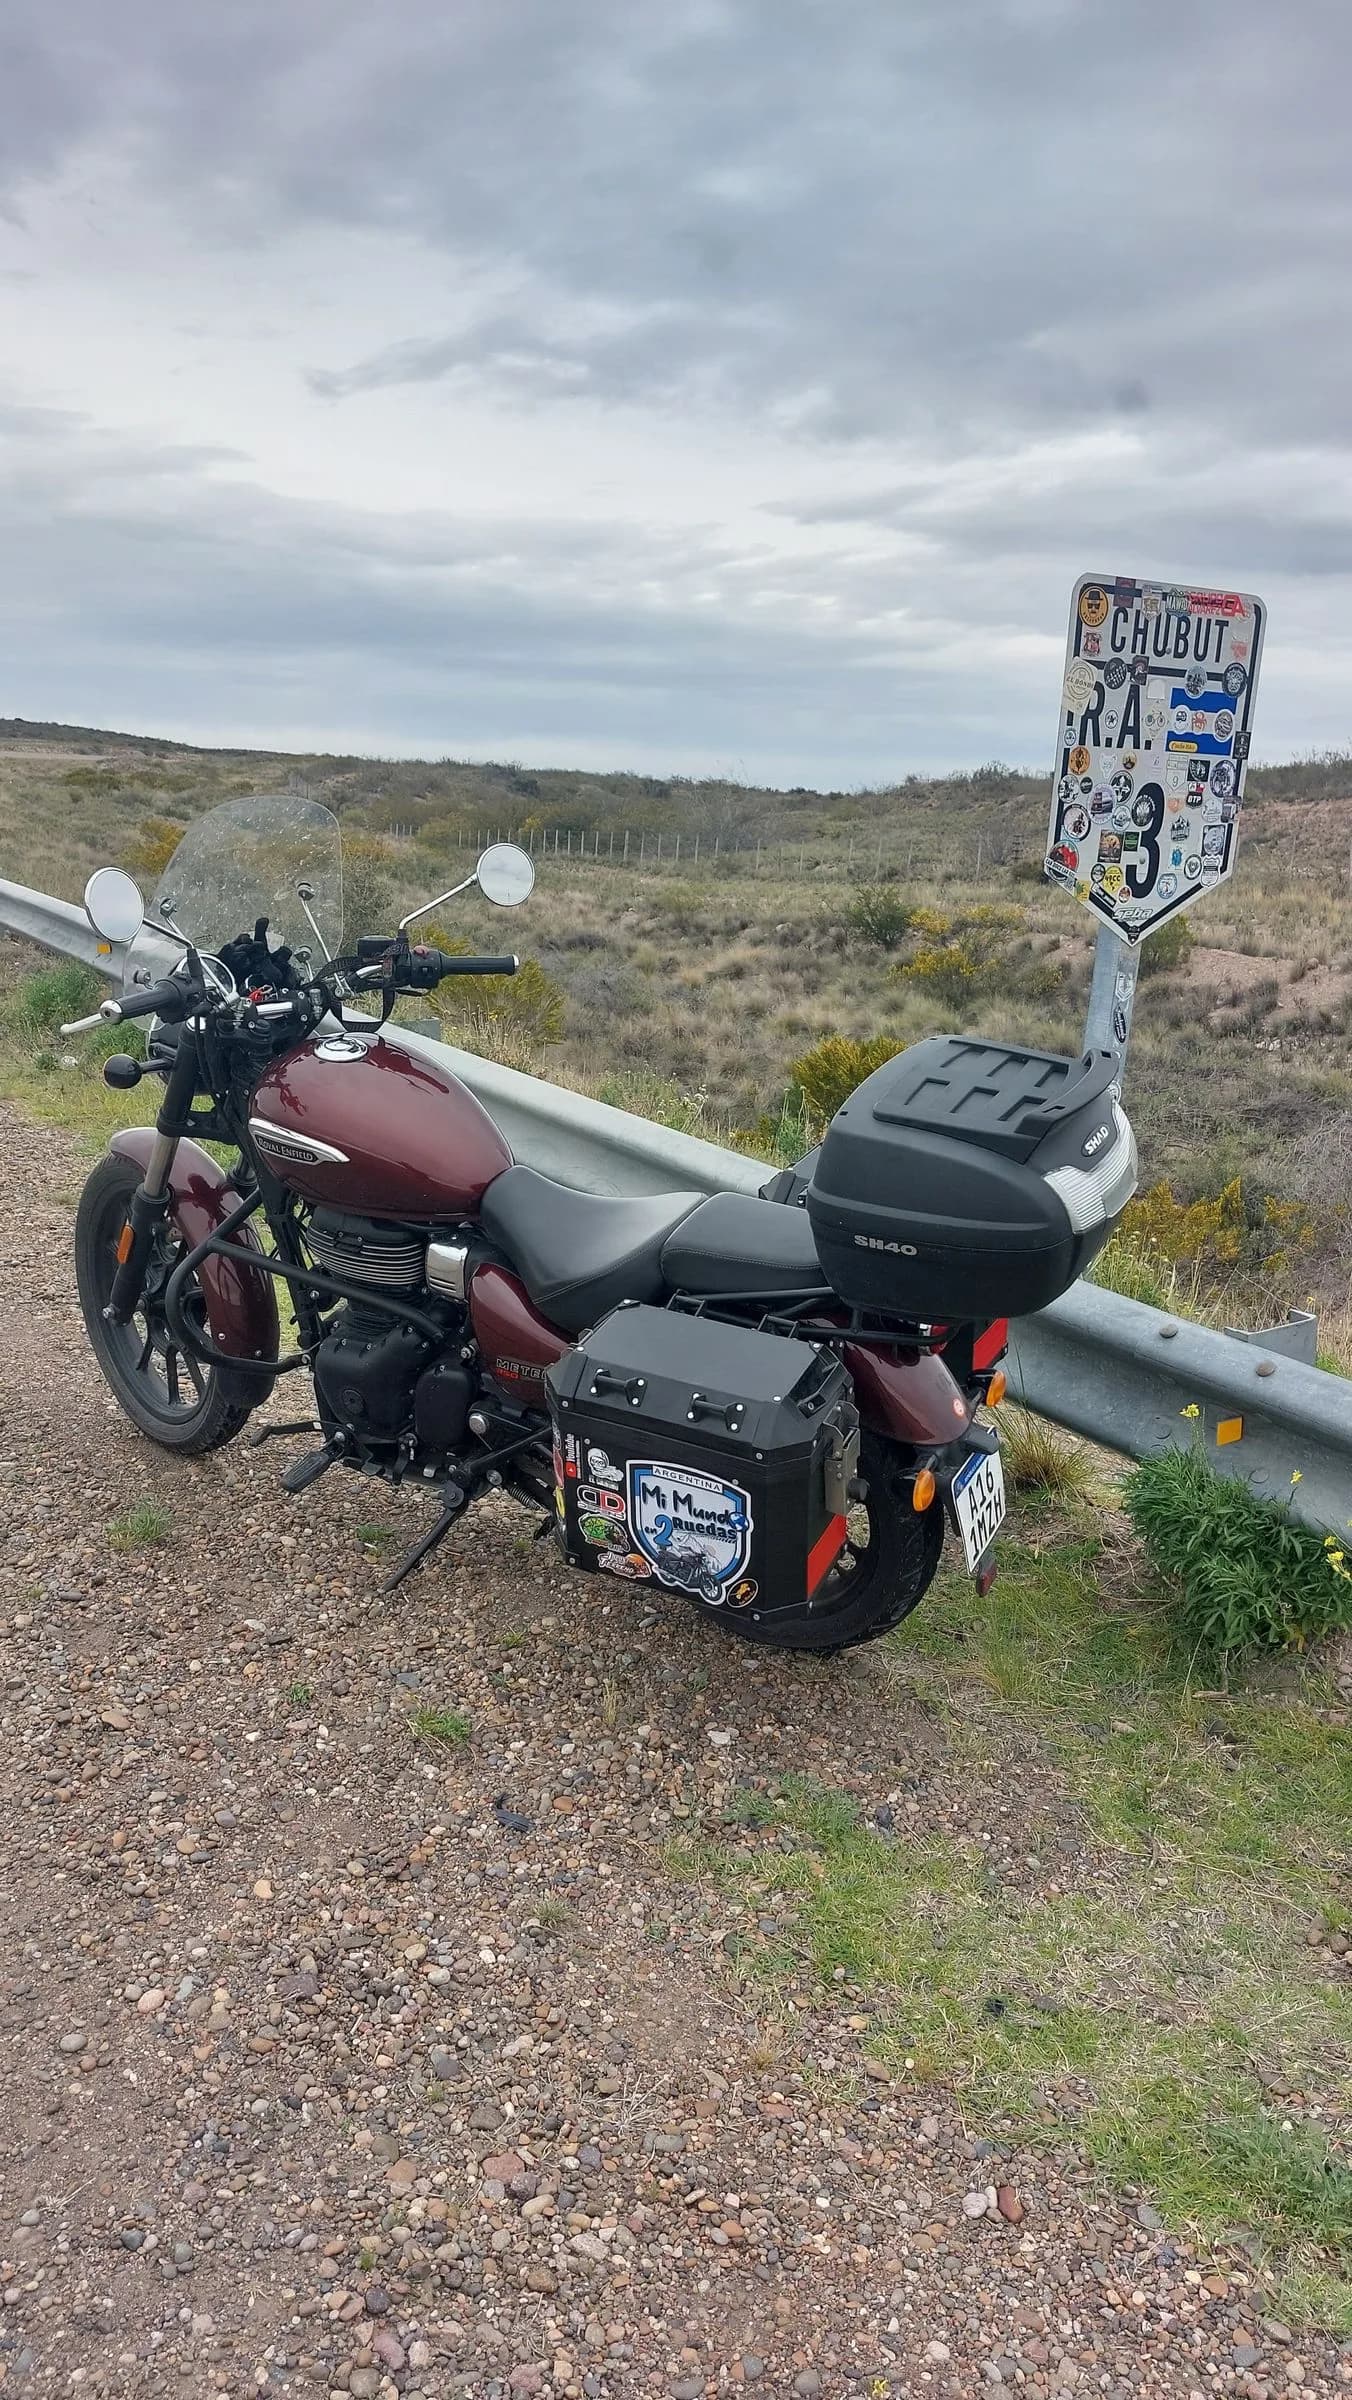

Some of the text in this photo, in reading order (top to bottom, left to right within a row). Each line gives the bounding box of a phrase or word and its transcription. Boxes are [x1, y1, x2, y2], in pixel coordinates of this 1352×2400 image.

[1110, 606, 1229, 663] CHUBUT
[1078, 680, 1152, 751] R.A.
[1126, 782, 1165, 899] 3
[258, 1137, 314, 1162] ROYAL ENFIELD
[1084, 1126, 1109, 1155] SHAD
[854, 1234, 918, 1256] SH40
[565, 1433, 576, 1461] YouTube
[653, 1466, 722, 1492] ARGENTINA
[967, 1459, 995, 1521] A16
[641, 1481, 668, 1510] Mi
[644, 1513, 738, 1547] en 2 Ruedas
[969, 1488, 1003, 1562] 1MZH
